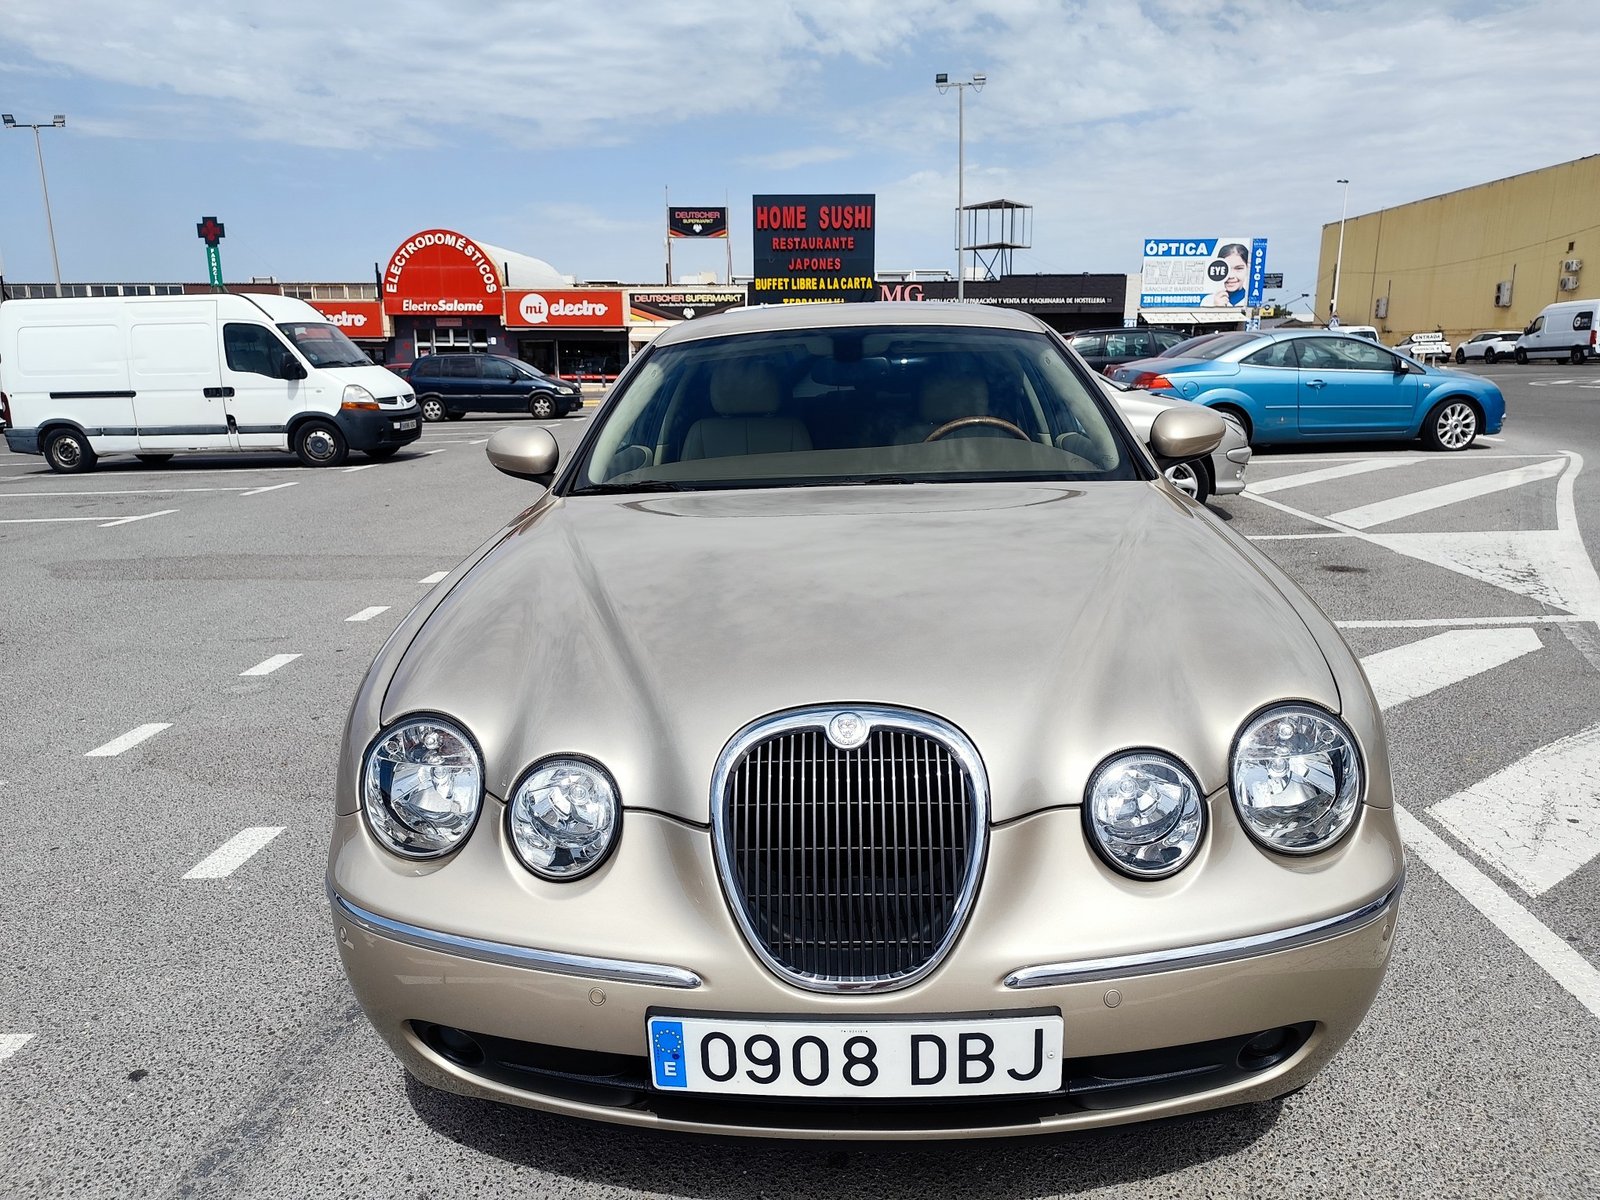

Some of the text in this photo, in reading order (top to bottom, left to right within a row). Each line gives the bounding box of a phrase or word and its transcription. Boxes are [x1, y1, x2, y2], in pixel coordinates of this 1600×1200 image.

[675, 211, 720, 219] DEUTSCHER
[756, 205, 872, 229] HOME SUSHI
[772, 237, 854, 250] RESTAURANTE
[1145, 240, 1209, 256] ÓPTICA
[210, 248, 219, 285] FARMACIA
[386, 233, 497, 293] ELECTRODOMÉSTICOS
[788, 257, 841, 271] JAPONES
[1209, 266, 1227, 276] EYE
[755, 277, 873, 291] BUFFET LIBRE A LA CARTA
[634, 294, 742, 303] DEUTSCHER SUPERMARKT
[880, 284, 925, 303] MG
[402, 299, 484, 312] ElectroSalomé
[525, 299, 609, 316] mi electro
[663, 1028, 1044, 1088] E 0908 DBJ
